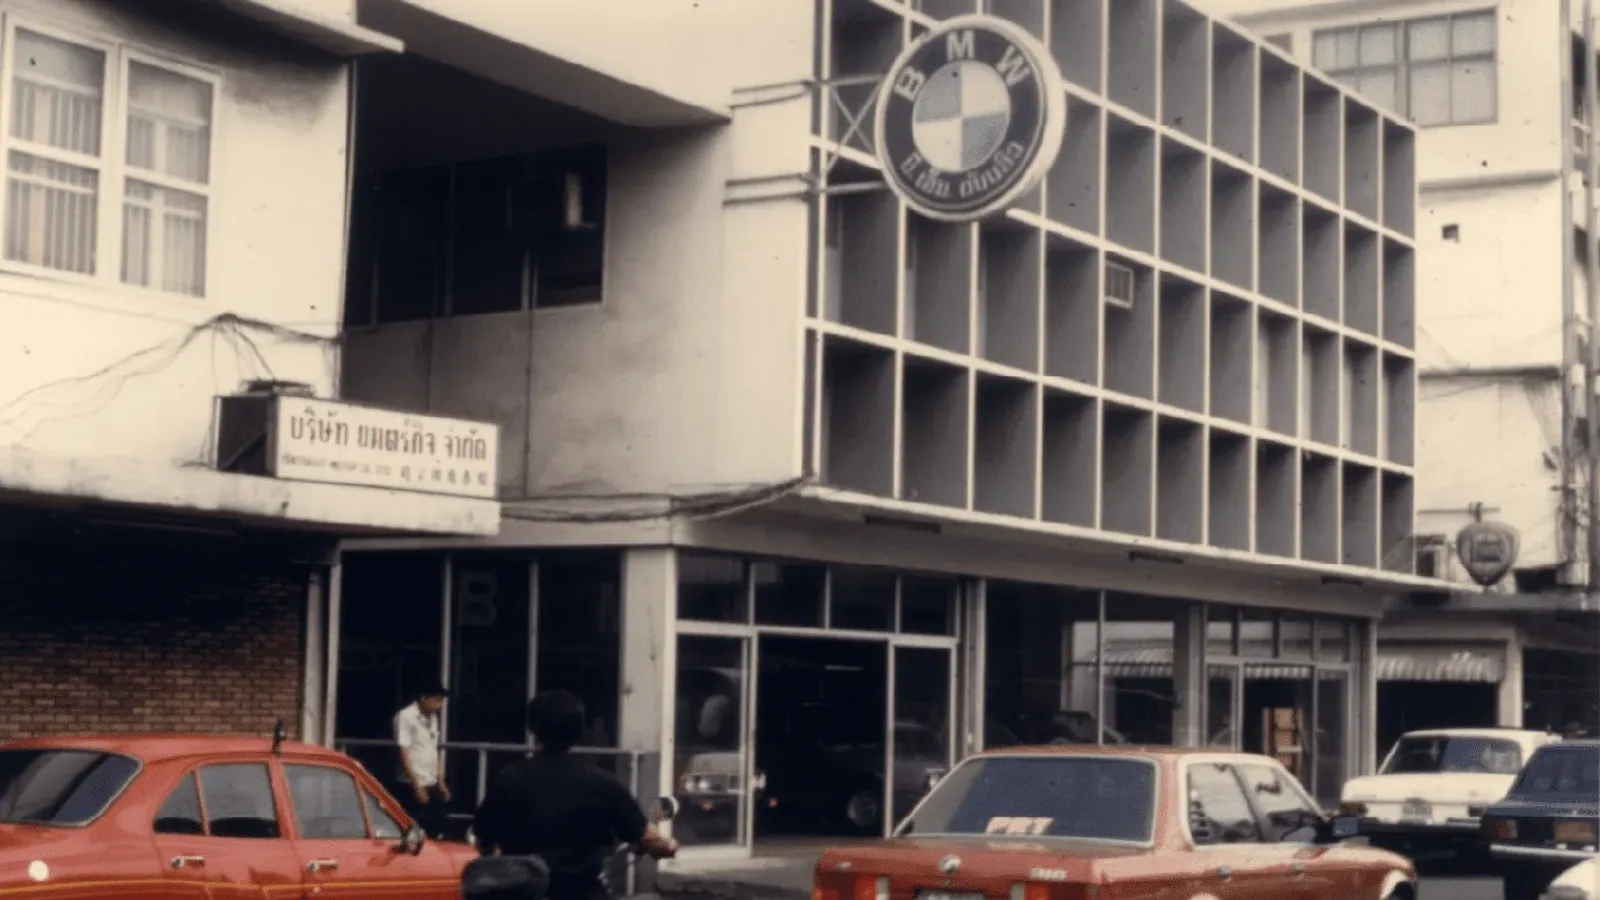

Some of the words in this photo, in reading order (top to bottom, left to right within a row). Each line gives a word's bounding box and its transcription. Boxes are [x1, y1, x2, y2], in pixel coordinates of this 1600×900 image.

[894, 29, 1030, 101] BMW
[290, 405, 349, 446] บริษัท
[444, 424, 487, 460] จำกัด
